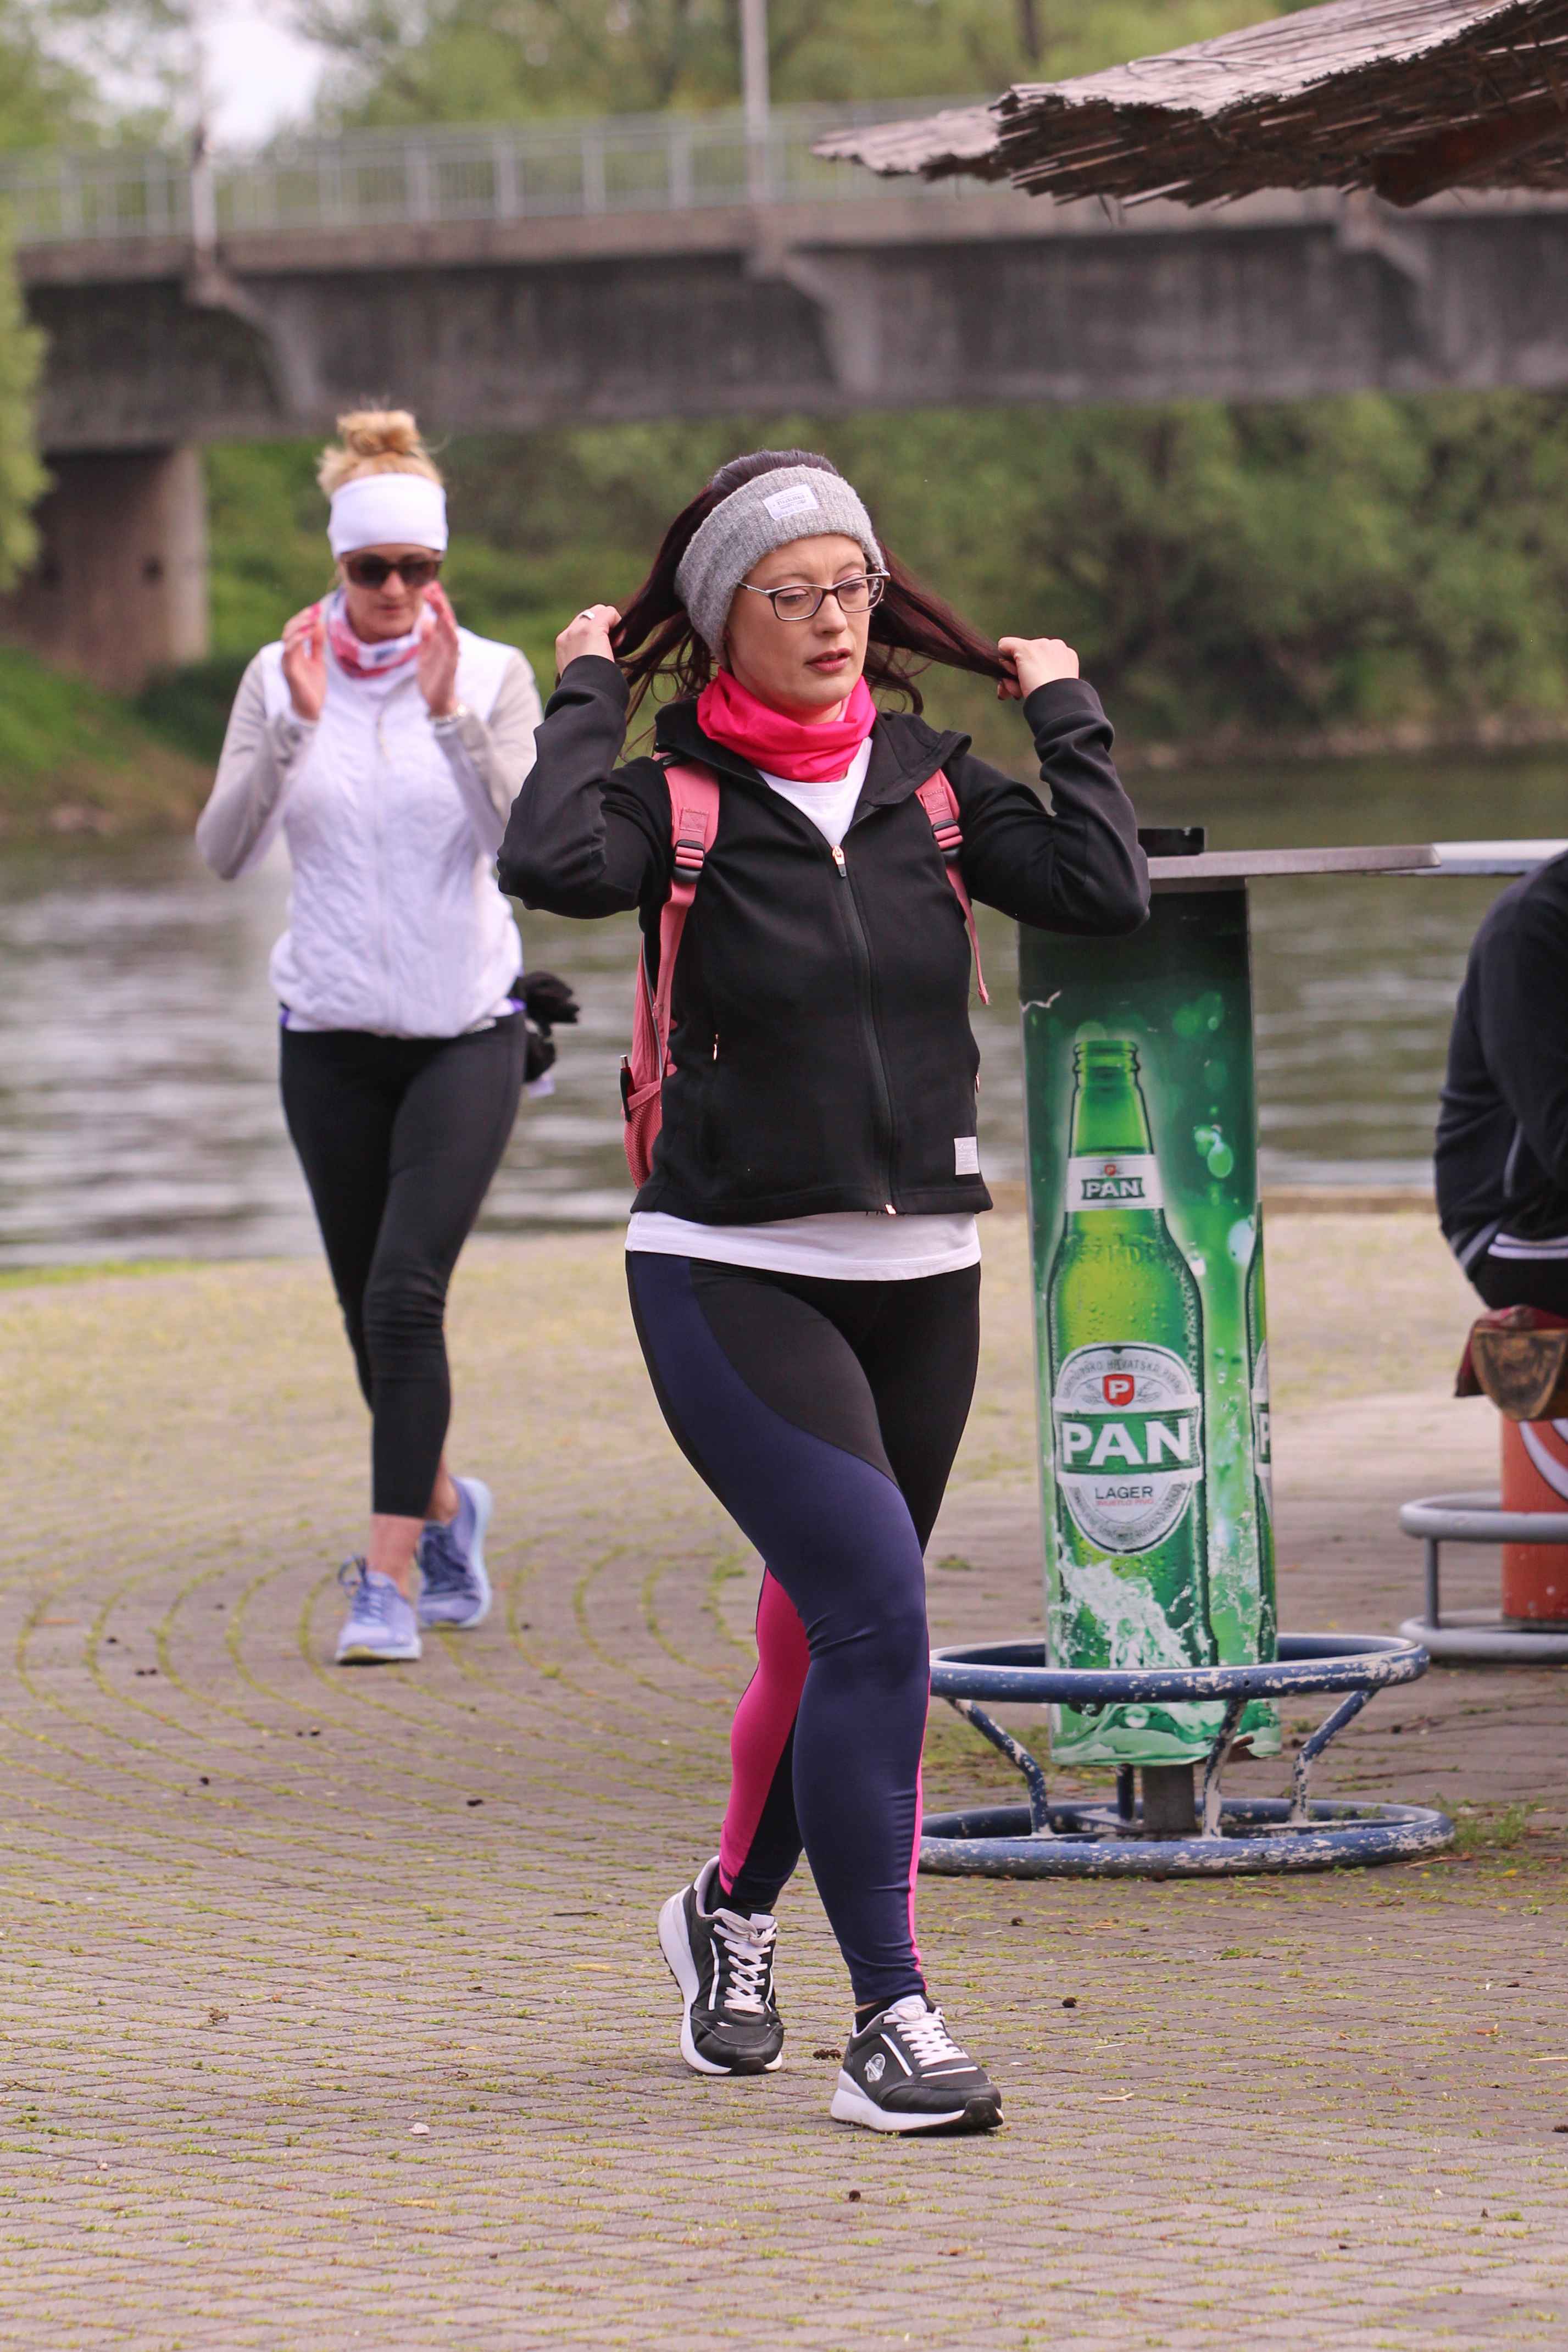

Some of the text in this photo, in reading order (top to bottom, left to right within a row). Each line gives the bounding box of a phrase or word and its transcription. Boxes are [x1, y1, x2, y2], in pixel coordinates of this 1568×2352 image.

[1086, 1180, 1139, 1198] PAN
[1108, 1380, 1130, 1399] P
[1061, 1417, 1191, 1466] PAN
[1094, 1486, 1153, 1499] LAGER
